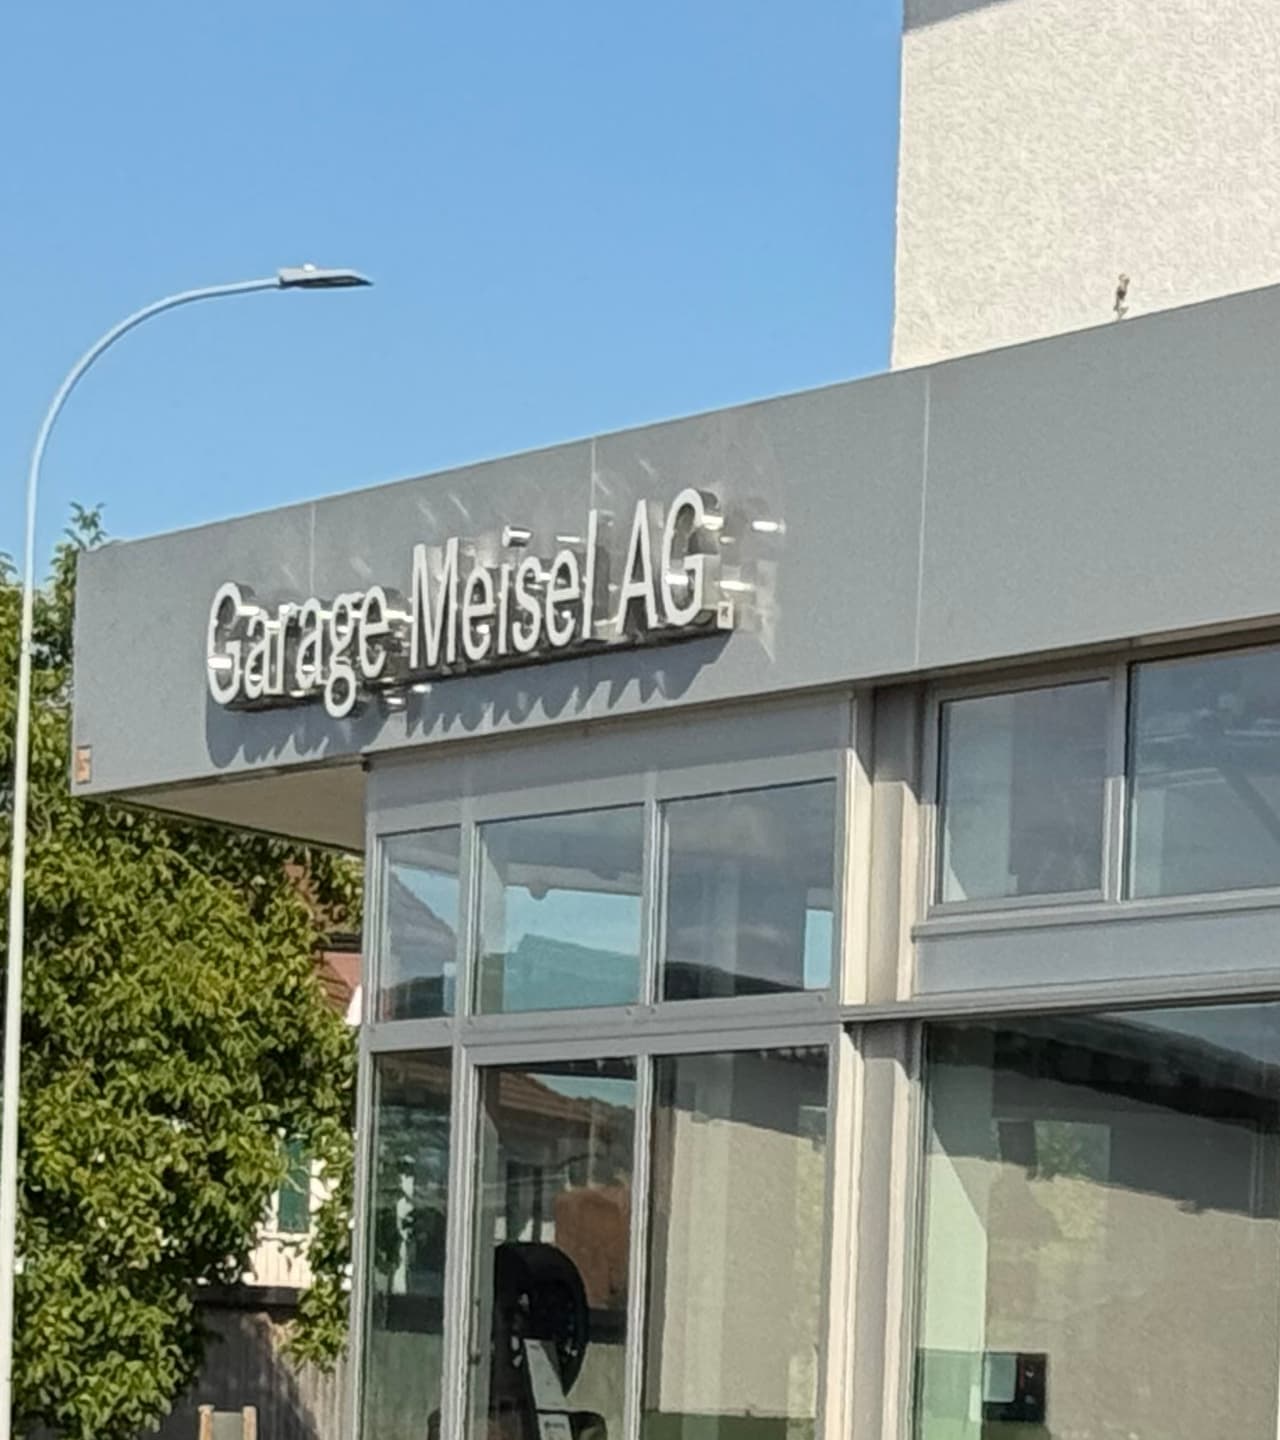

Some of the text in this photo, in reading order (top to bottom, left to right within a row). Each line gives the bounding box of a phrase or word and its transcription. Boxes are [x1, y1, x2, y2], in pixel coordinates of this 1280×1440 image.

[206, 487, 706, 719] Garage Meisel AG
